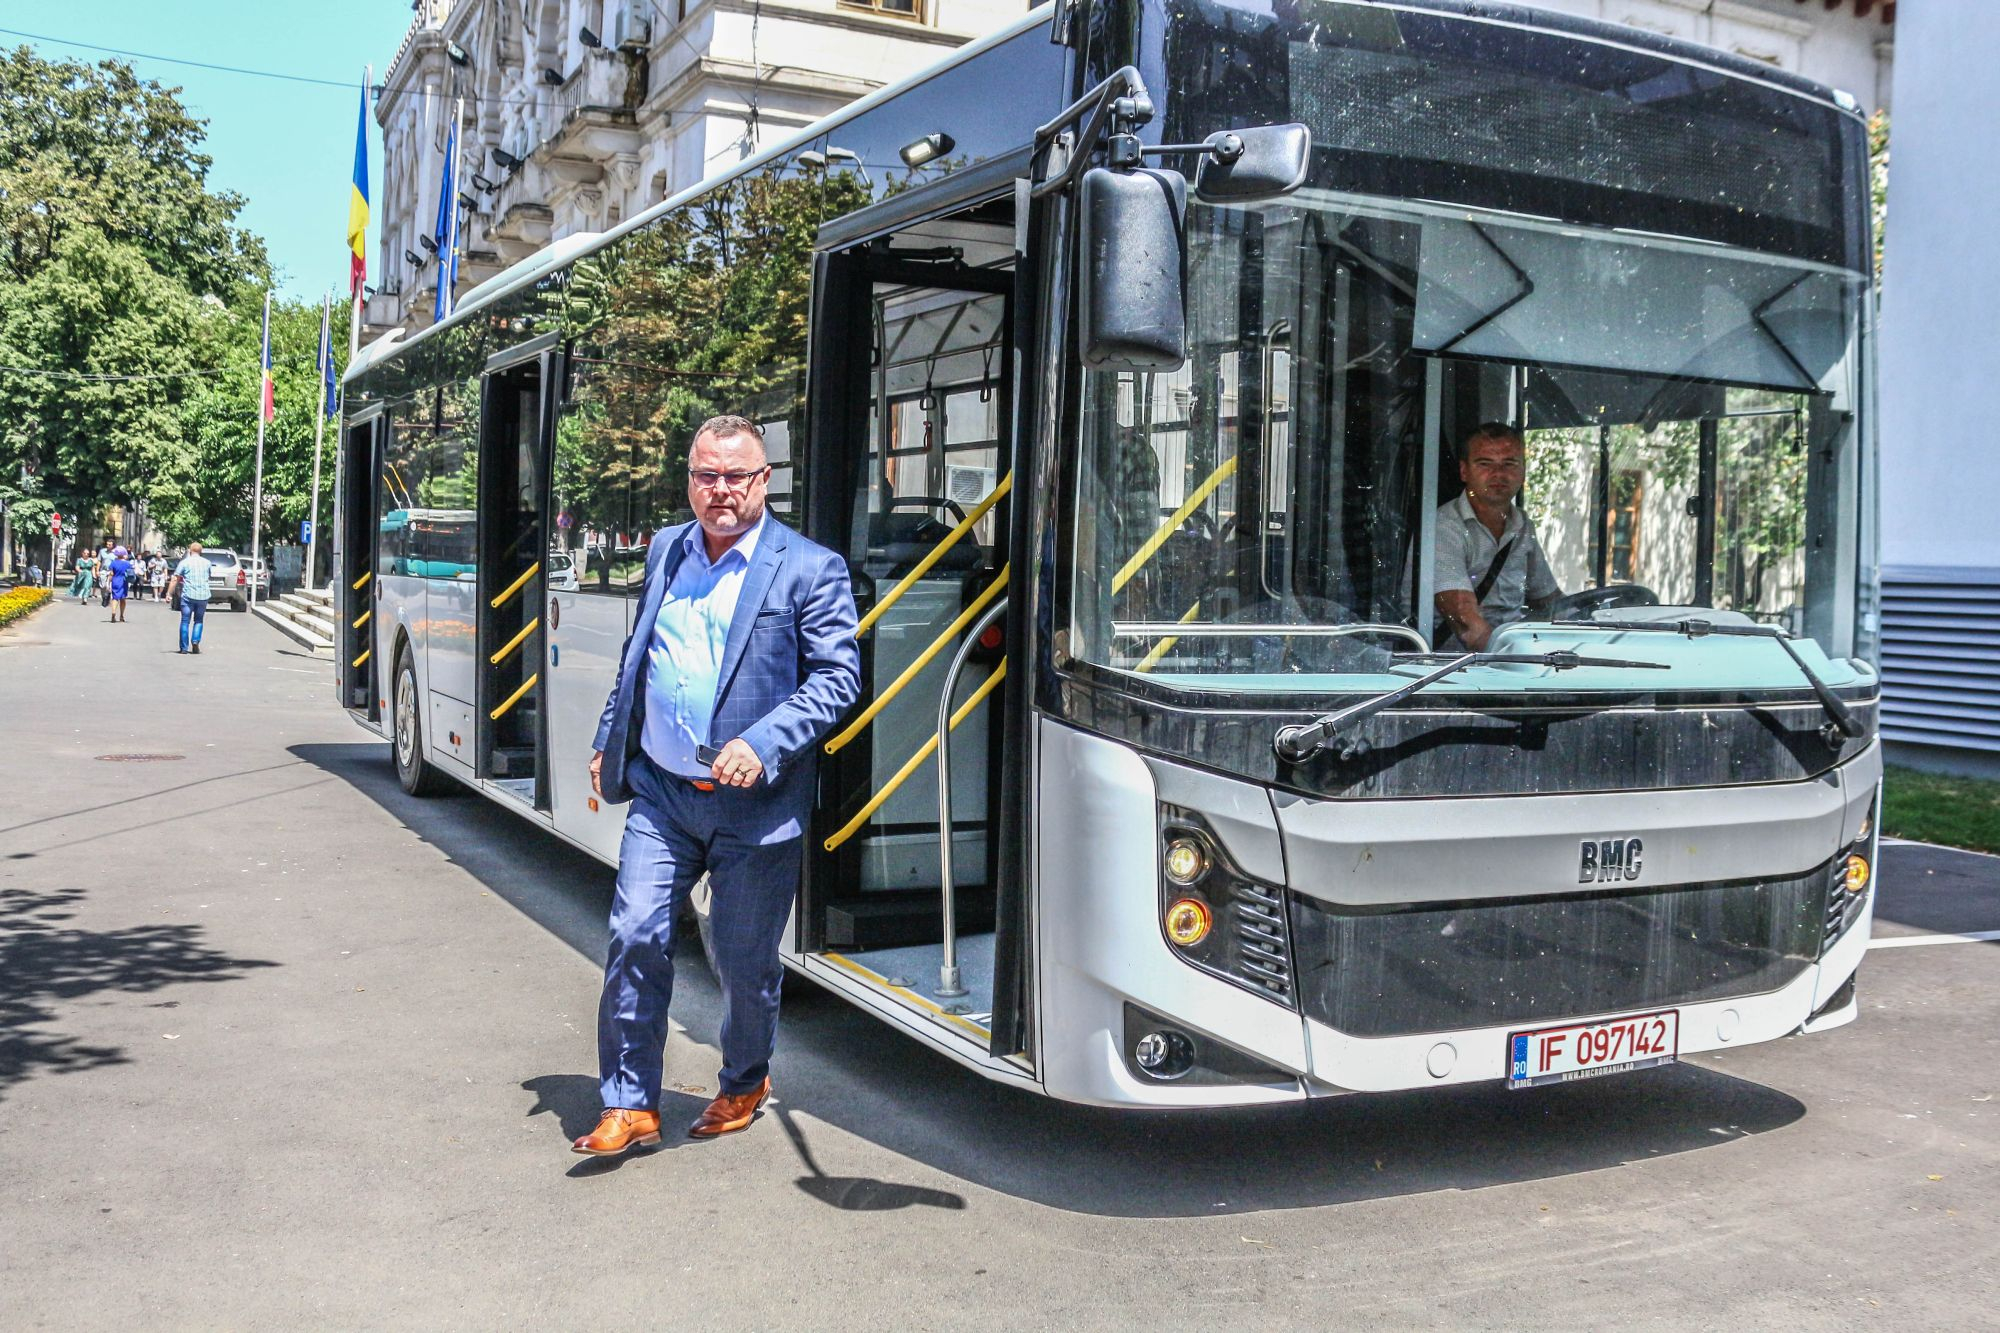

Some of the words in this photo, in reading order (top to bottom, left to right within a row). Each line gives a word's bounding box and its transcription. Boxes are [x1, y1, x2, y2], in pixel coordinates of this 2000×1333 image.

[304, 523, 311, 541] P
[1579, 838, 1643, 884] BMC
[1539, 1035, 1566, 1072] IF
[1576, 1020, 1666, 1065] 097142
[1513, 1061, 1526, 1075] RO
[1562, 1062, 1634, 1081] WWW.BMCROMANIA.RO
